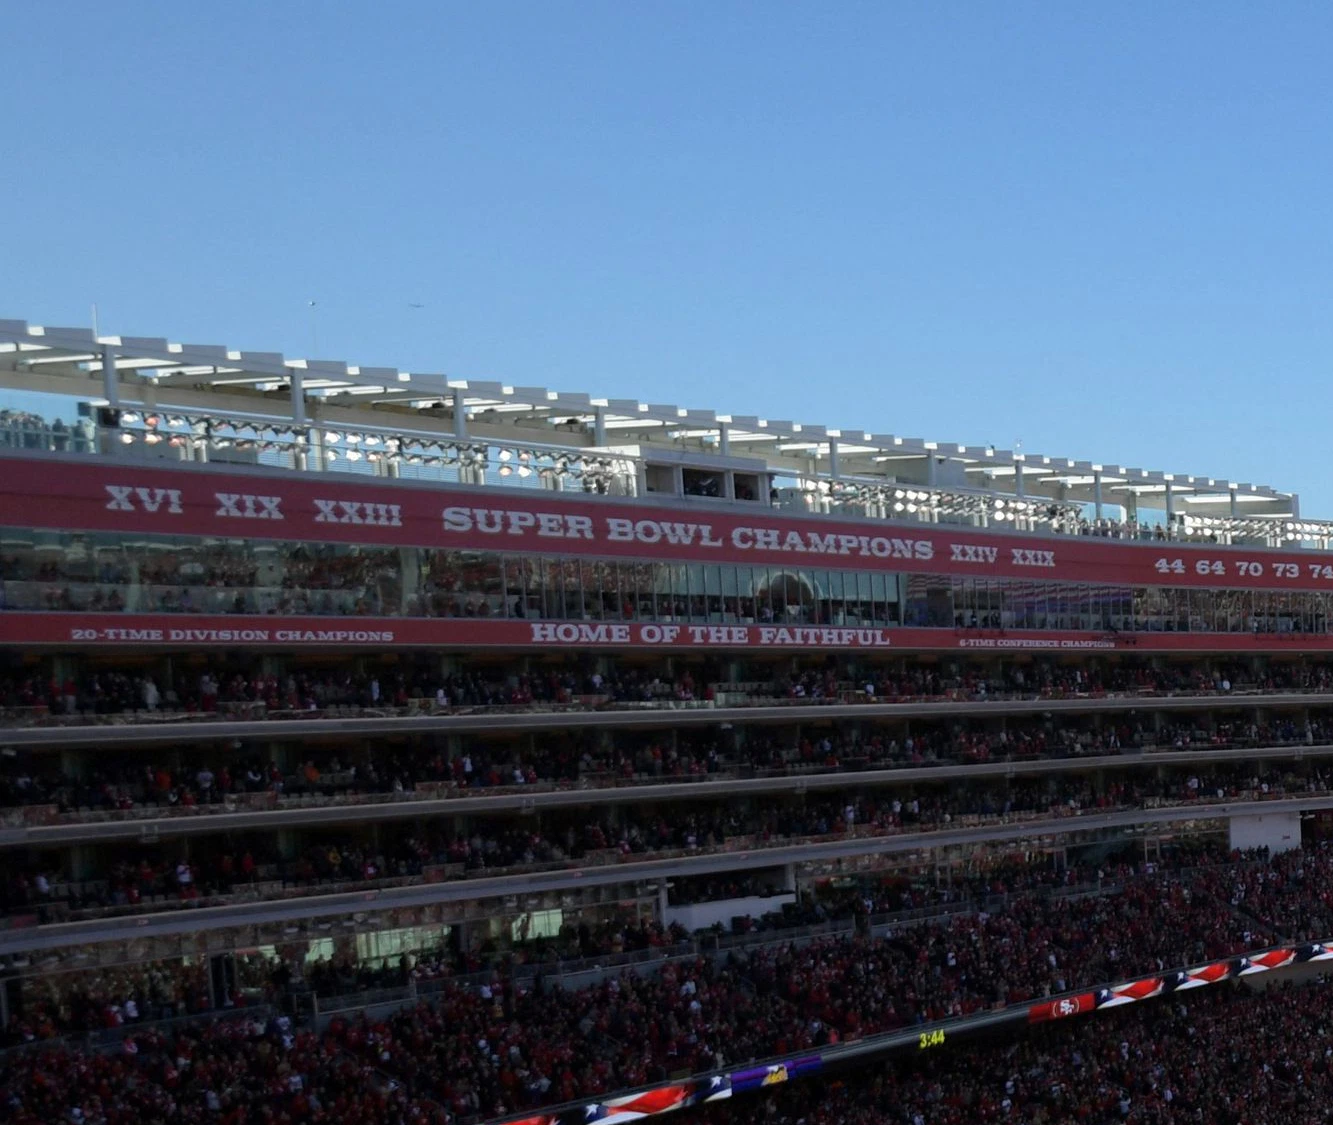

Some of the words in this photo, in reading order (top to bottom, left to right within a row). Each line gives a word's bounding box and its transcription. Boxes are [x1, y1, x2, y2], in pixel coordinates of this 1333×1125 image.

[105, 485, 183, 514] XVI
[215, 492, 284, 519] XIX
[313, 499, 402, 526] XXIII
[442, 506, 594, 540] SUPER
[606, 517, 722, 548] BOWL
[731, 526, 934, 560] CHAMPIONS
[950, 543, 998, 563] XXIV
[1011, 547, 1056, 567] XXIX
[1155, 557, 1185, 574] 44
[1195, 559, 1226, 575] 64
[1236, 561, 1263, 577] 70
[1272, 562, 1299, 578] 73
[71, 628, 163, 641] 20-TIME
[170, 629, 270, 642] DIVISION
[274, 630, 394, 642] CHAMPIONS
[530, 623, 631, 643] HOME
[640, 624, 680, 644] OF
[688, 625, 749, 644] THE
[759, 627, 890, 646] FAITHFUL
[959, 638, 996, 648] 6-TIME
[997, 639, 1060, 648] CONFERENCE
[1060, 640, 1116, 649] CHAMPIONS
[919, 1028, 945, 1049] 3:44
